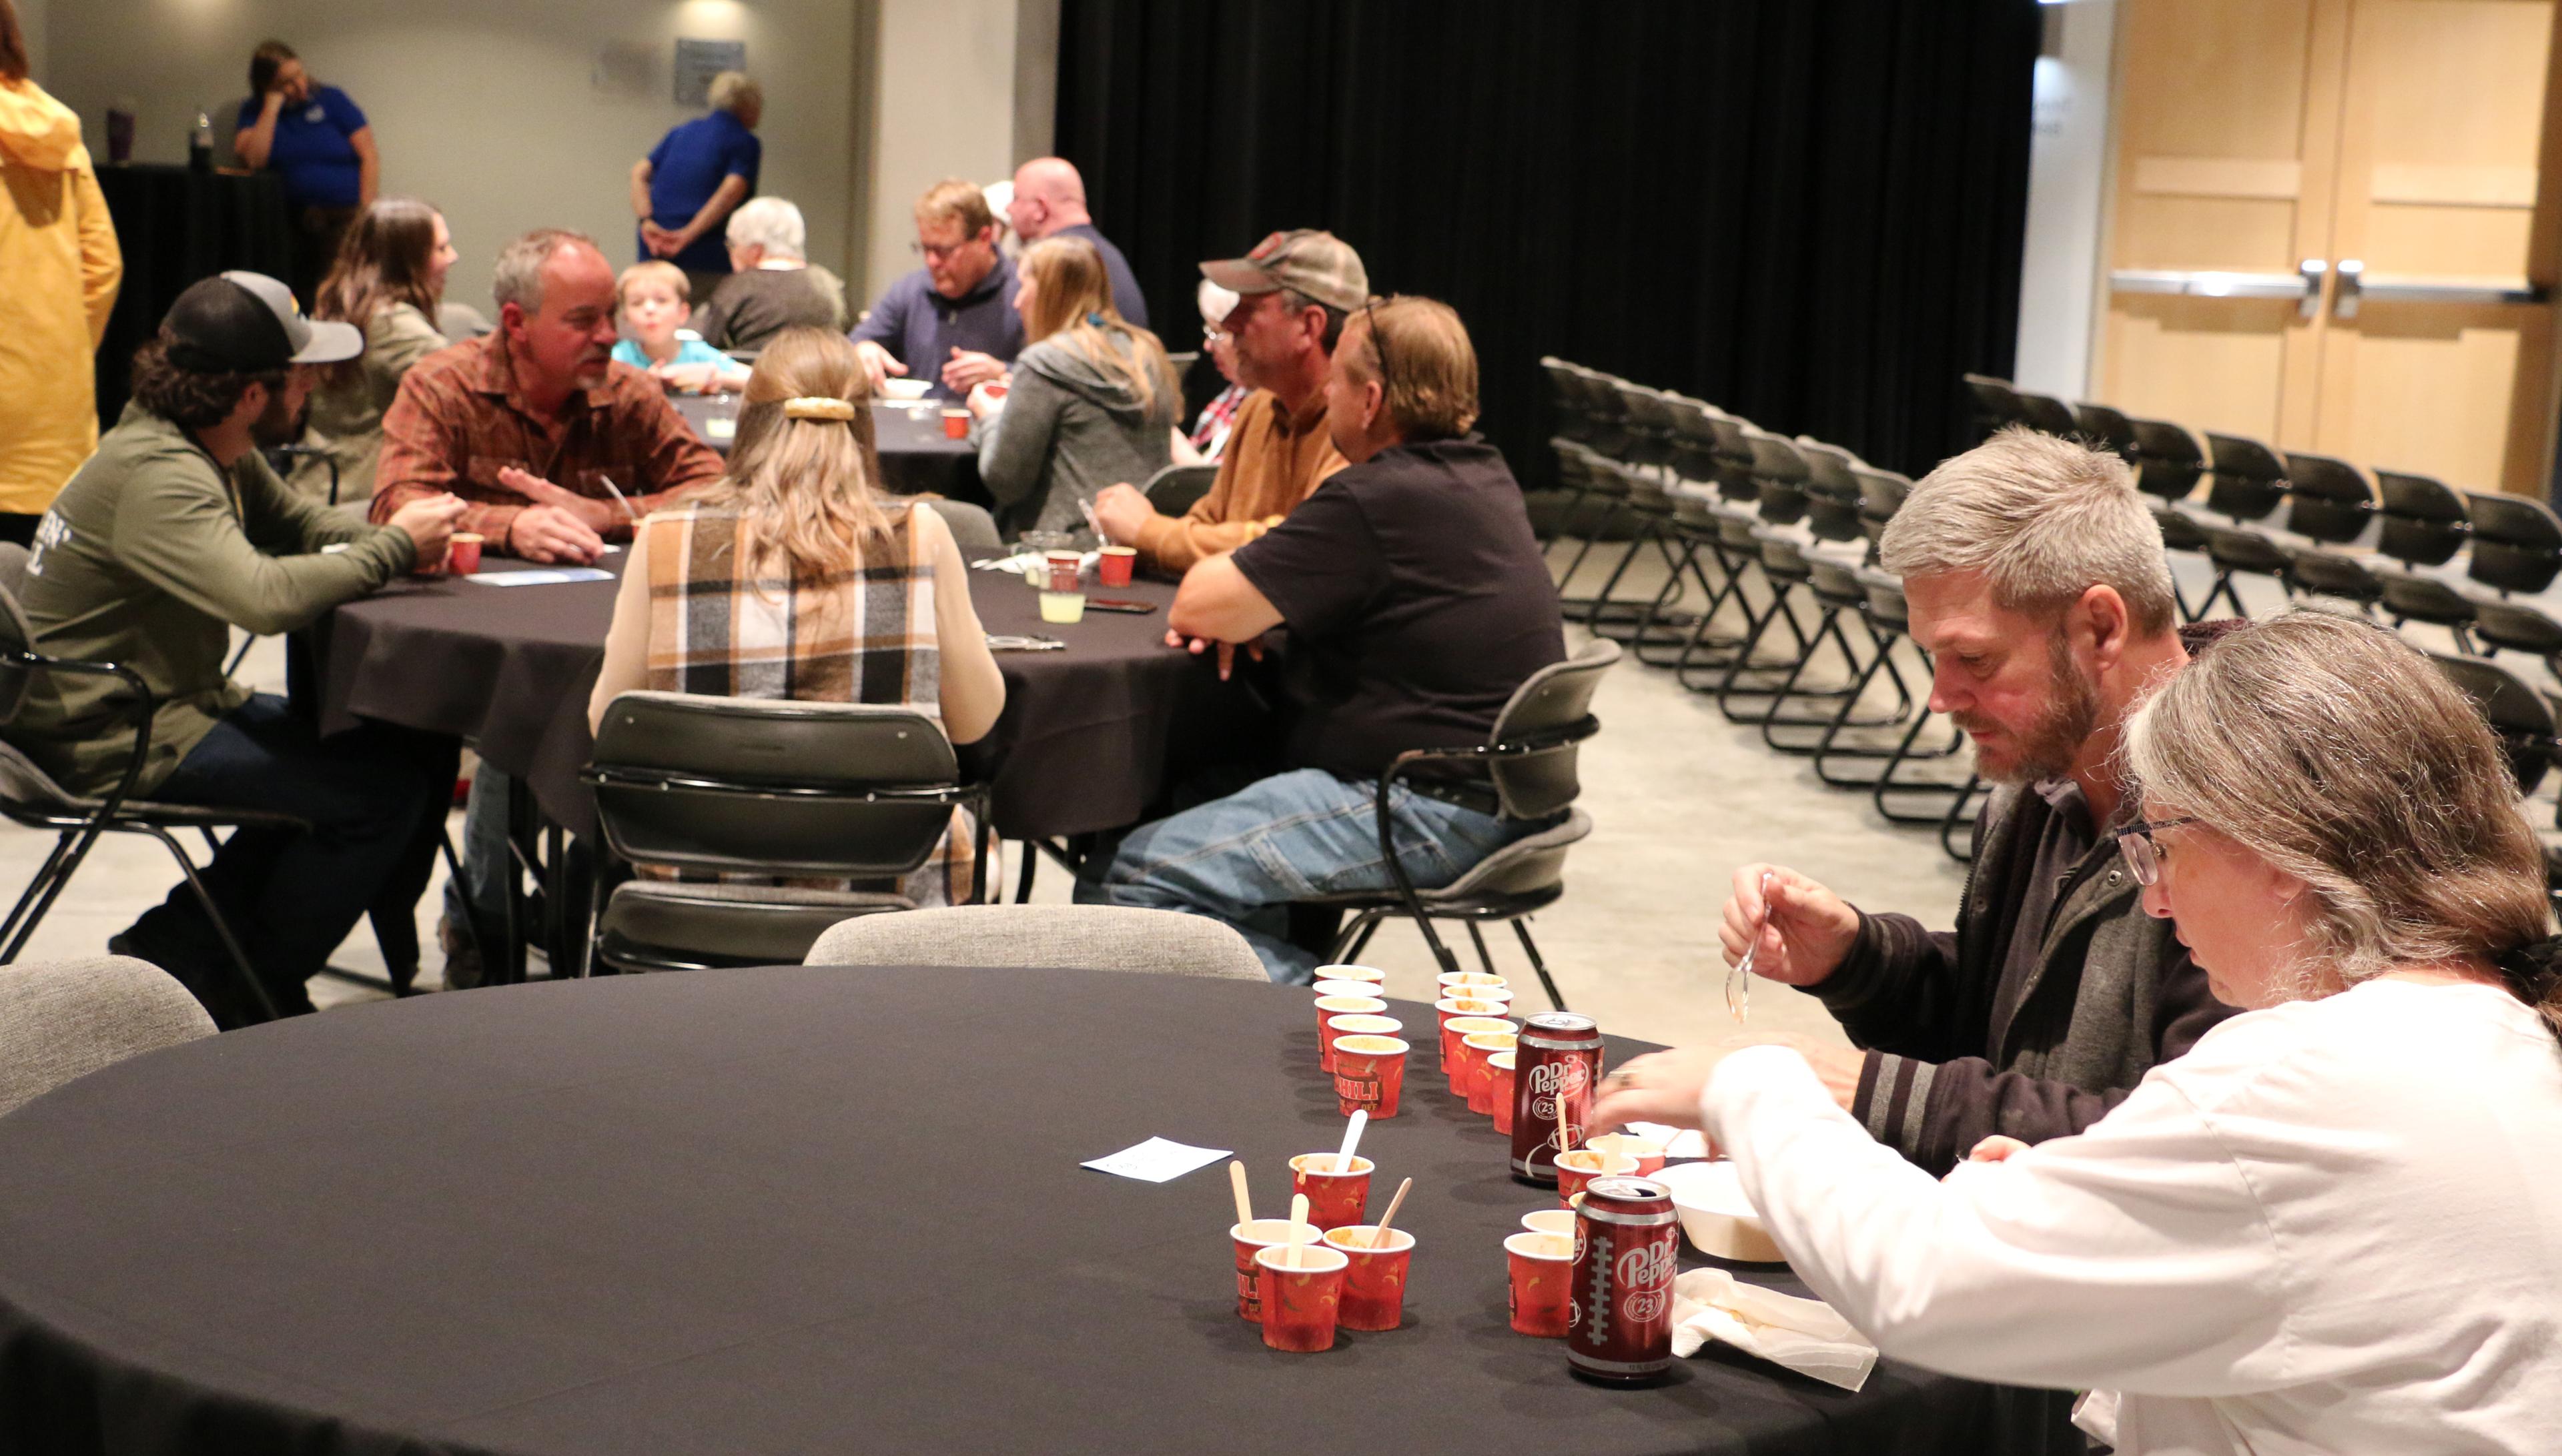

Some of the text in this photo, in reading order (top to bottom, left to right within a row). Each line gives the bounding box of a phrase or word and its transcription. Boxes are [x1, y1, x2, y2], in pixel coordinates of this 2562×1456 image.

[1529, 1064, 1585, 1095] Pepper
[1550, 1061, 1572, 1080] Dr
[1338, 1076, 1378, 1101] HILI
[1541, 1101, 1555, 1114] 23
[1649, 1240, 1671, 1266] Dr
[1637, 1298, 1654, 1314] 23
